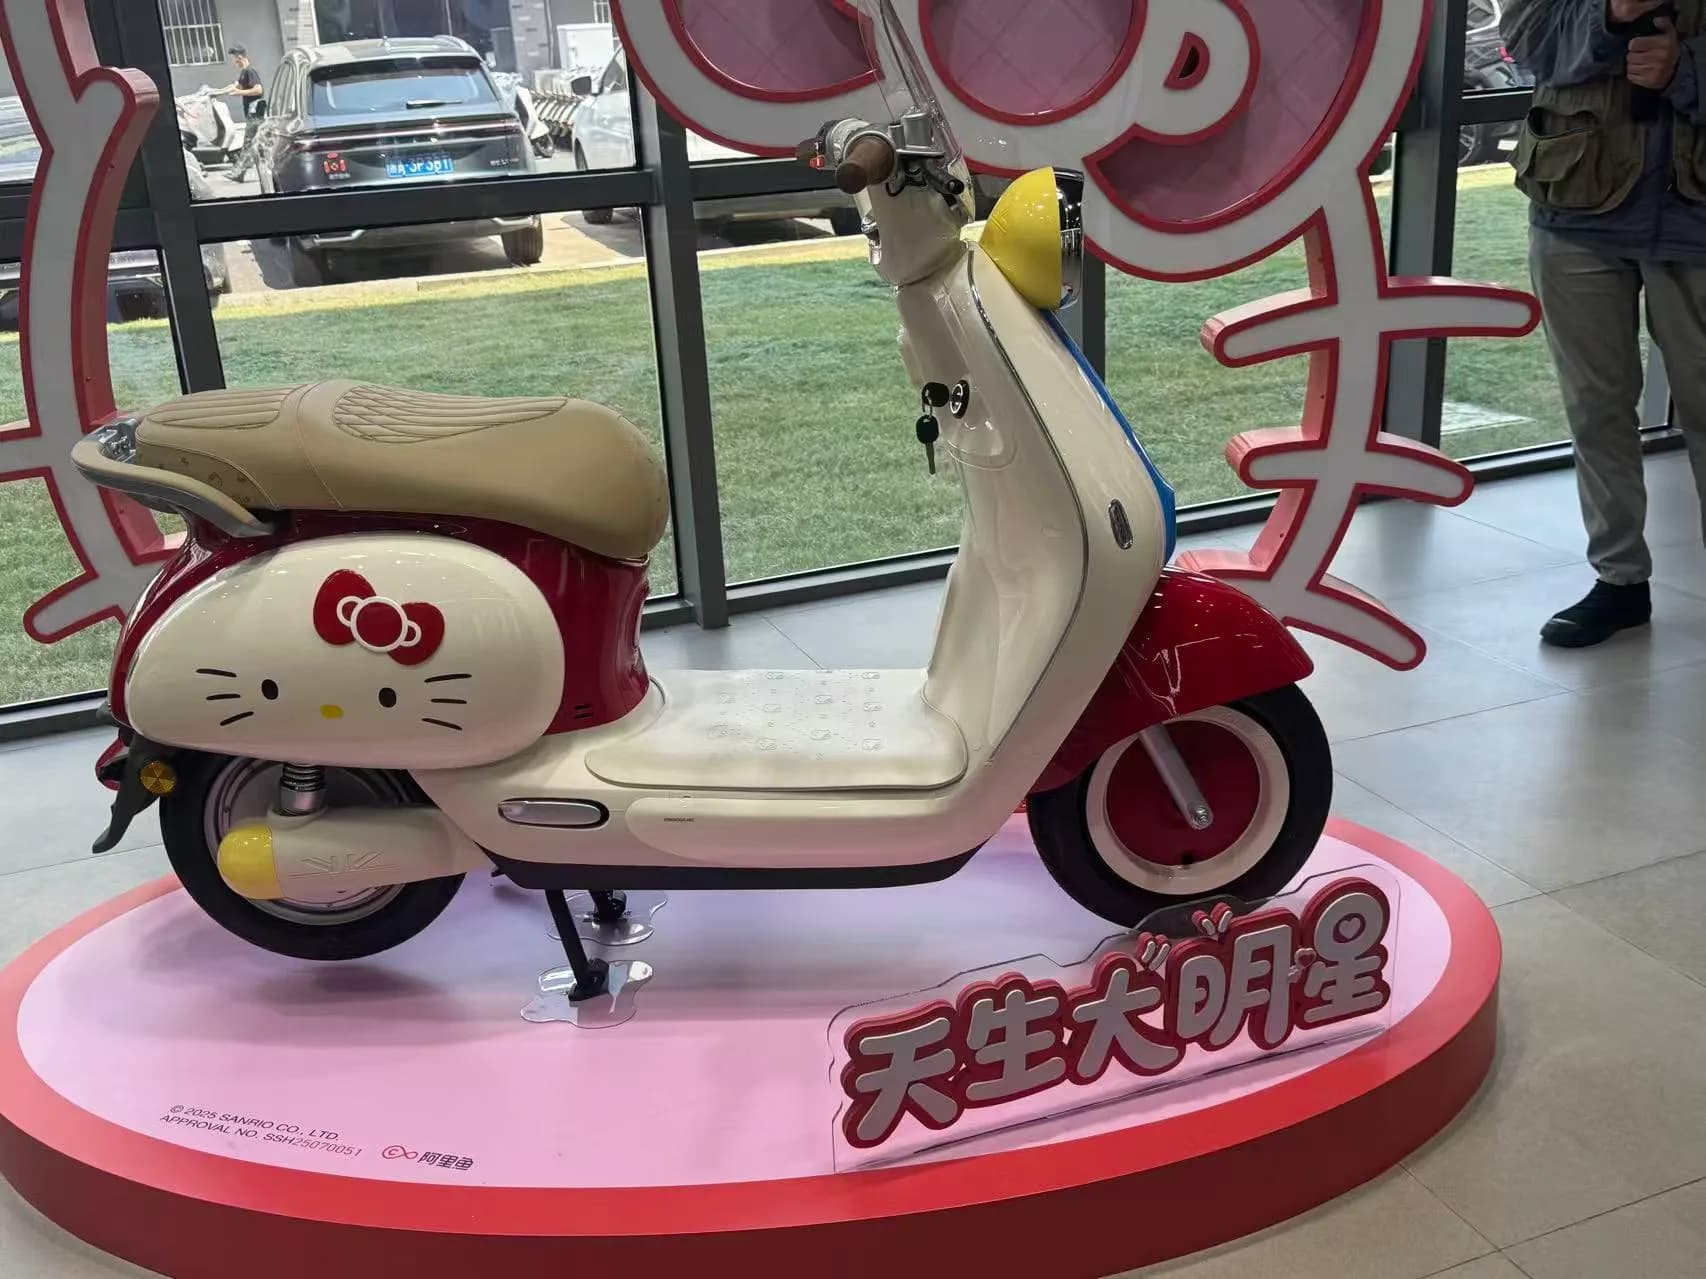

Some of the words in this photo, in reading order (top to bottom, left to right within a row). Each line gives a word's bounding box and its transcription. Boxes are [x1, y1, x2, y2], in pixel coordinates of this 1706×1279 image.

[854, 890, 1386, 1142] 天生大明星
[160, 1115, 231, 1134] APPROVAL
[235, 1128, 259, 1139] NO.
[263, 1133, 363, 1157] SSH25070051
[184, 1107, 216, 1119] 2025
[219, 1113, 275, 1130] SANRIO
[276, 1123, 304, 1135] CO.,
[308, 1129, 340, 1141] LTD.
[418, 1151, 474, 1171] 阿里鱼
